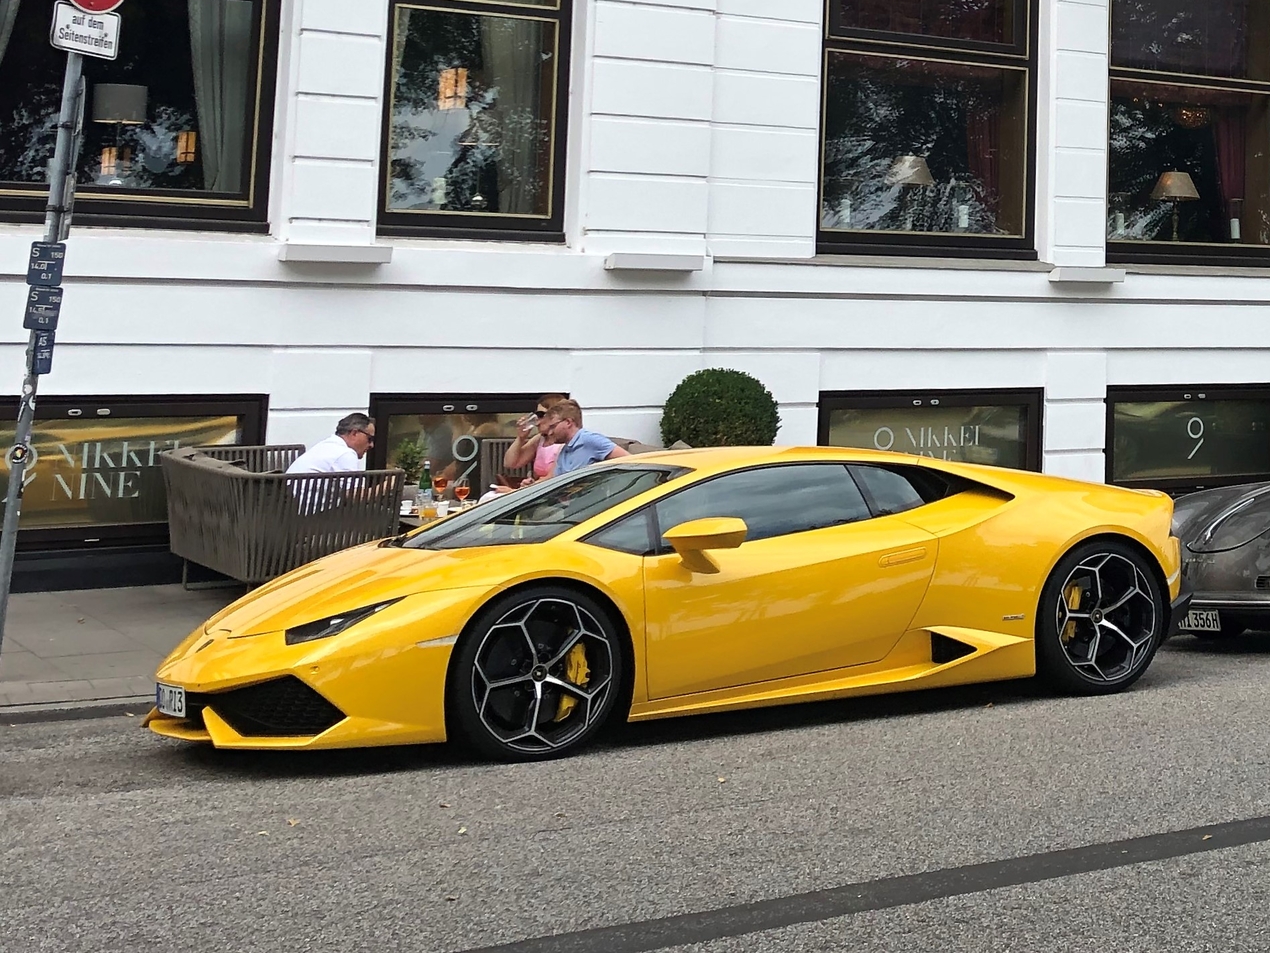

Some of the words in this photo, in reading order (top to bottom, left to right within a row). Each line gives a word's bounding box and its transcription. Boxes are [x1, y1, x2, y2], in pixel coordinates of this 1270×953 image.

[72, 14, 86, 26] auf
[88, 16, 104, 30] dem
[59, 27, 113, 49] Seitenstreifen
[32, 247, 40, 257] S
[31, 291, 39, 301] S
[905, 425, 980, 448] NIKKEI
[1187, 417, 1204, 459] 9
[452, 434, 479, 488] 9
[52, 471, 141, 501] NINE
[1192, 612, 1218, 629] 356H
